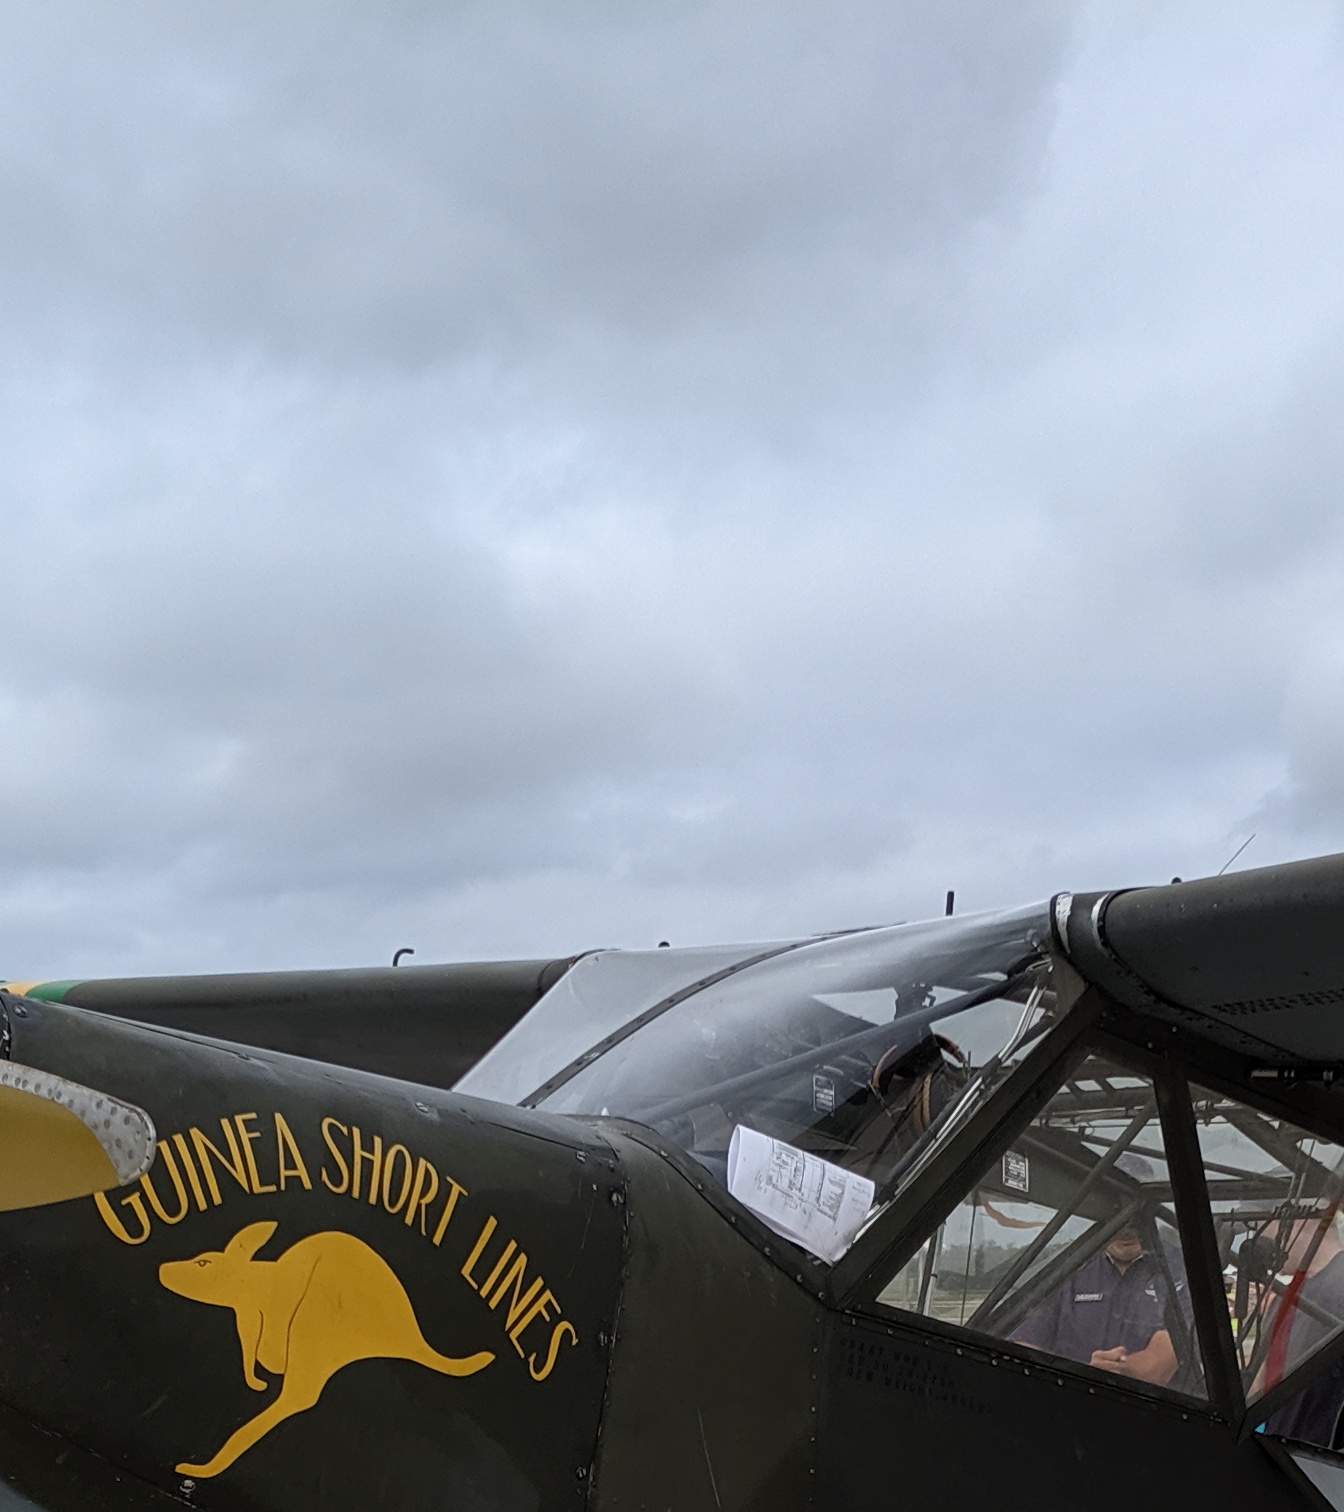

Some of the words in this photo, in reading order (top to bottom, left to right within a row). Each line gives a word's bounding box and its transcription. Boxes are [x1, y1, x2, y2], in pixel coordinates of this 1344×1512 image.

[93, 1111, 312, 1245] GUINEA
[321, 1116, 469, 1247] SHORT
[460, 1215, 579, 1382] LINES
